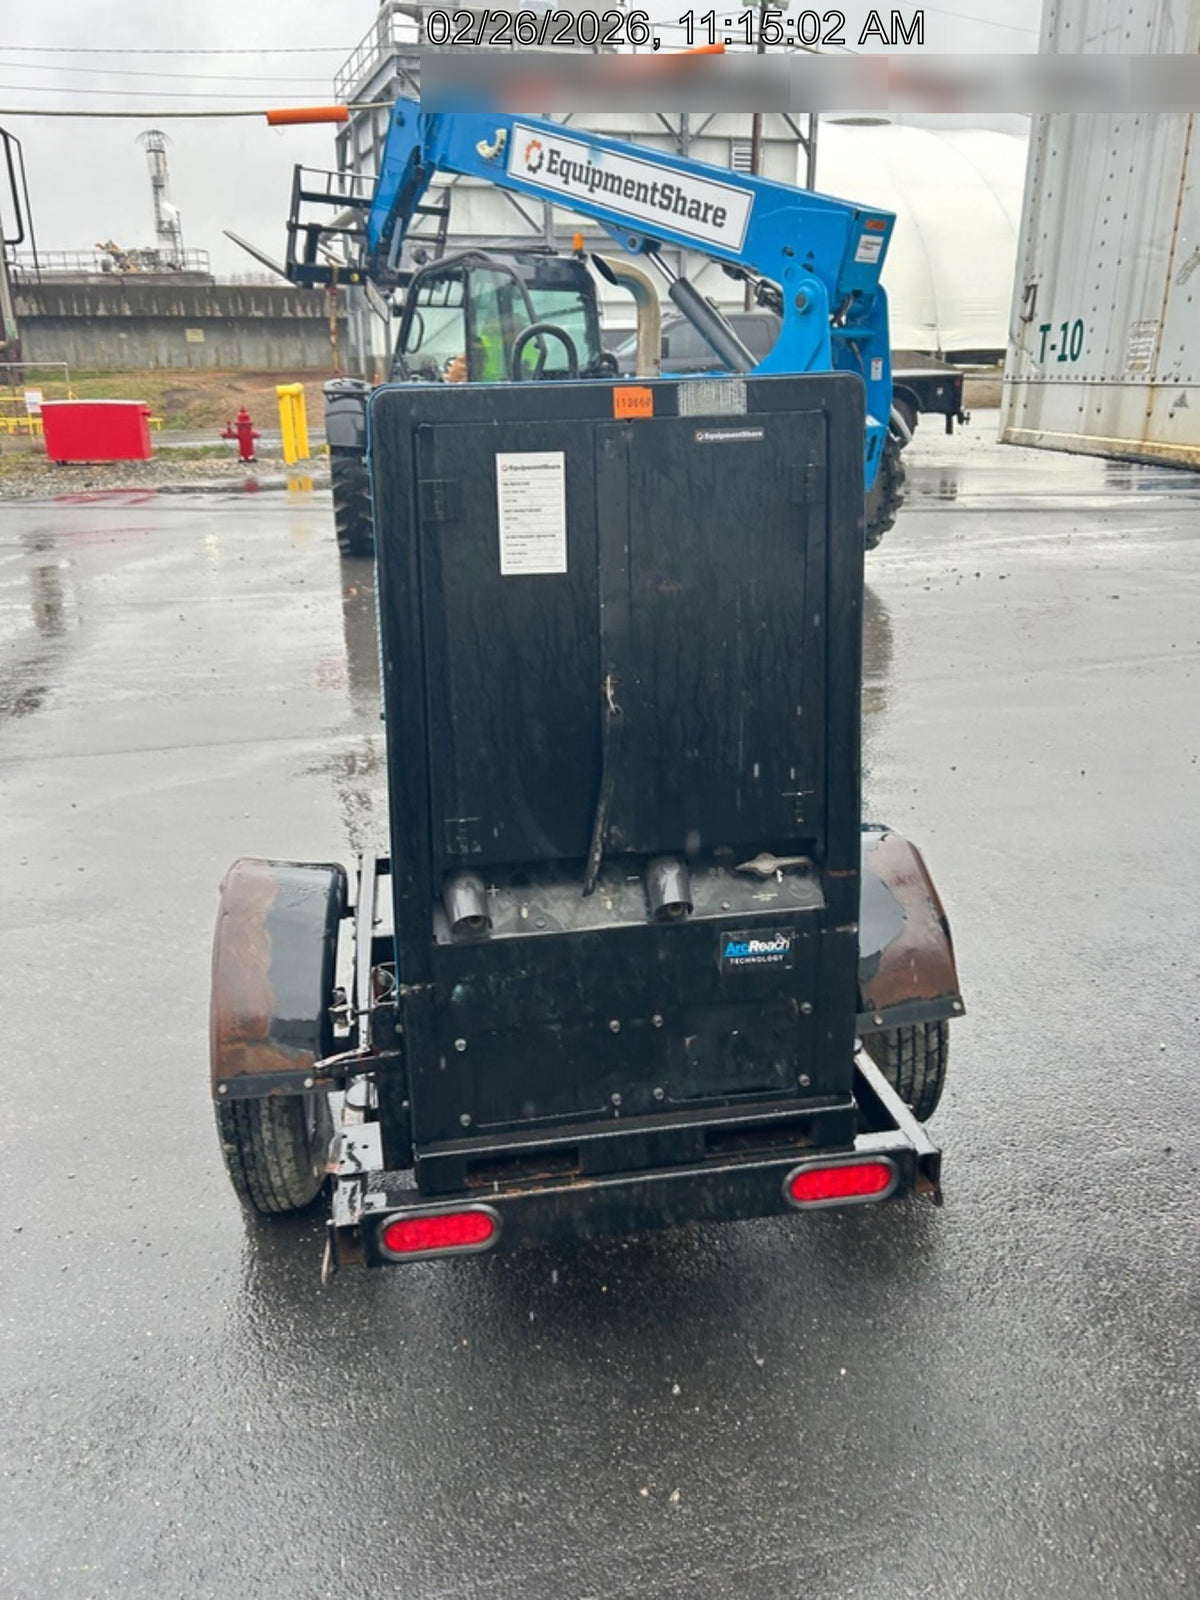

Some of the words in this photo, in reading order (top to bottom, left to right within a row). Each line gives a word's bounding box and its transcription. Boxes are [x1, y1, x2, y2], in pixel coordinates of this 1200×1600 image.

[545, 148, 727, 229] EquipmentShare
[1039, 318, 1084, 363] T-10
[725, 939, 790, 955] ArcReach
[729, 955, 783, 965] TECHNOLOGY
